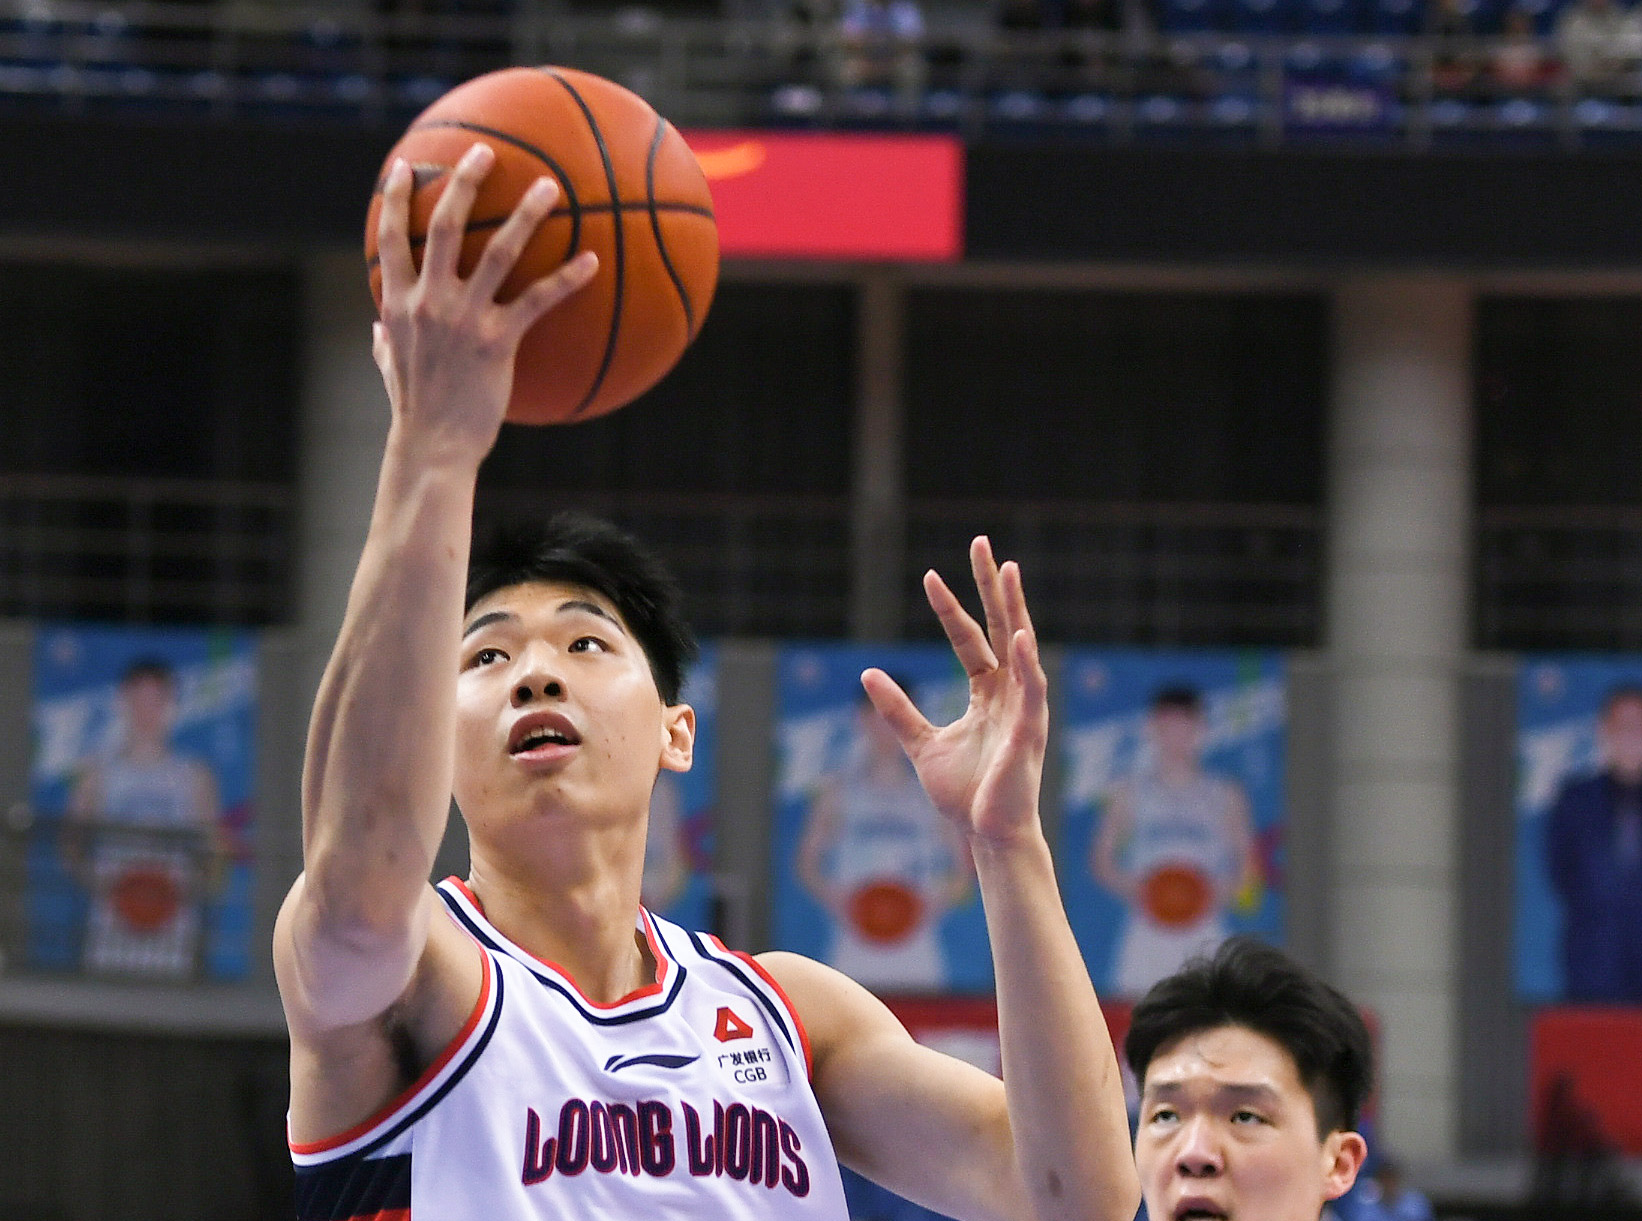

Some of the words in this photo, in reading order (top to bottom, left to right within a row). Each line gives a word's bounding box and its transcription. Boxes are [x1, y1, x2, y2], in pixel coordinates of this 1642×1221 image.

[734, 1067, 767, 1084] CGB
[521, 1098, 676, 1186] LOONG
[680, 1098, 811, 1198] LIONS
